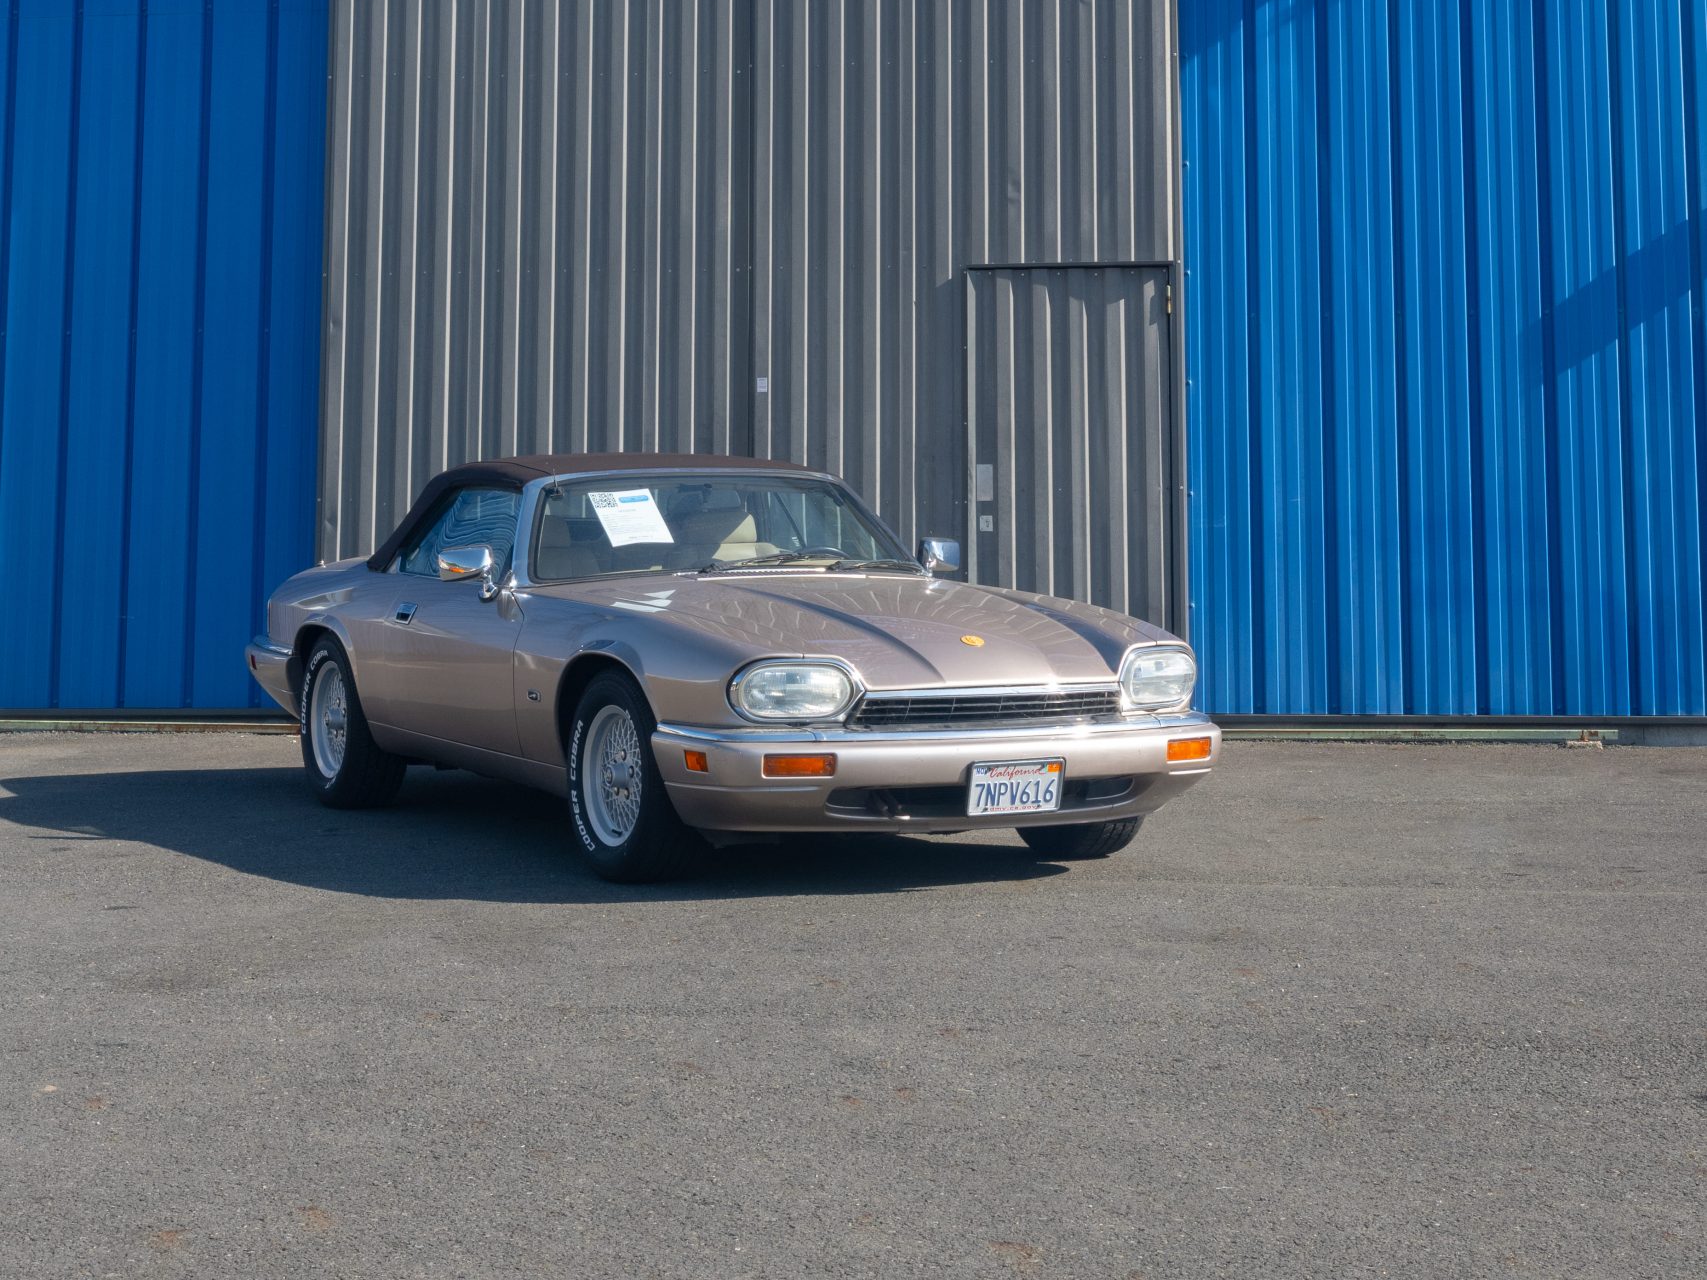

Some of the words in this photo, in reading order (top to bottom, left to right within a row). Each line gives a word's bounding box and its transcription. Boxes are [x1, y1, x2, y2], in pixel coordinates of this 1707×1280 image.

[570, 720, 583, 780] COBRA
[975, 779, 1056, 807] 7NPV616
[989, 765, 1046, 780] California
[571, 790, 595, 851] COOPER
